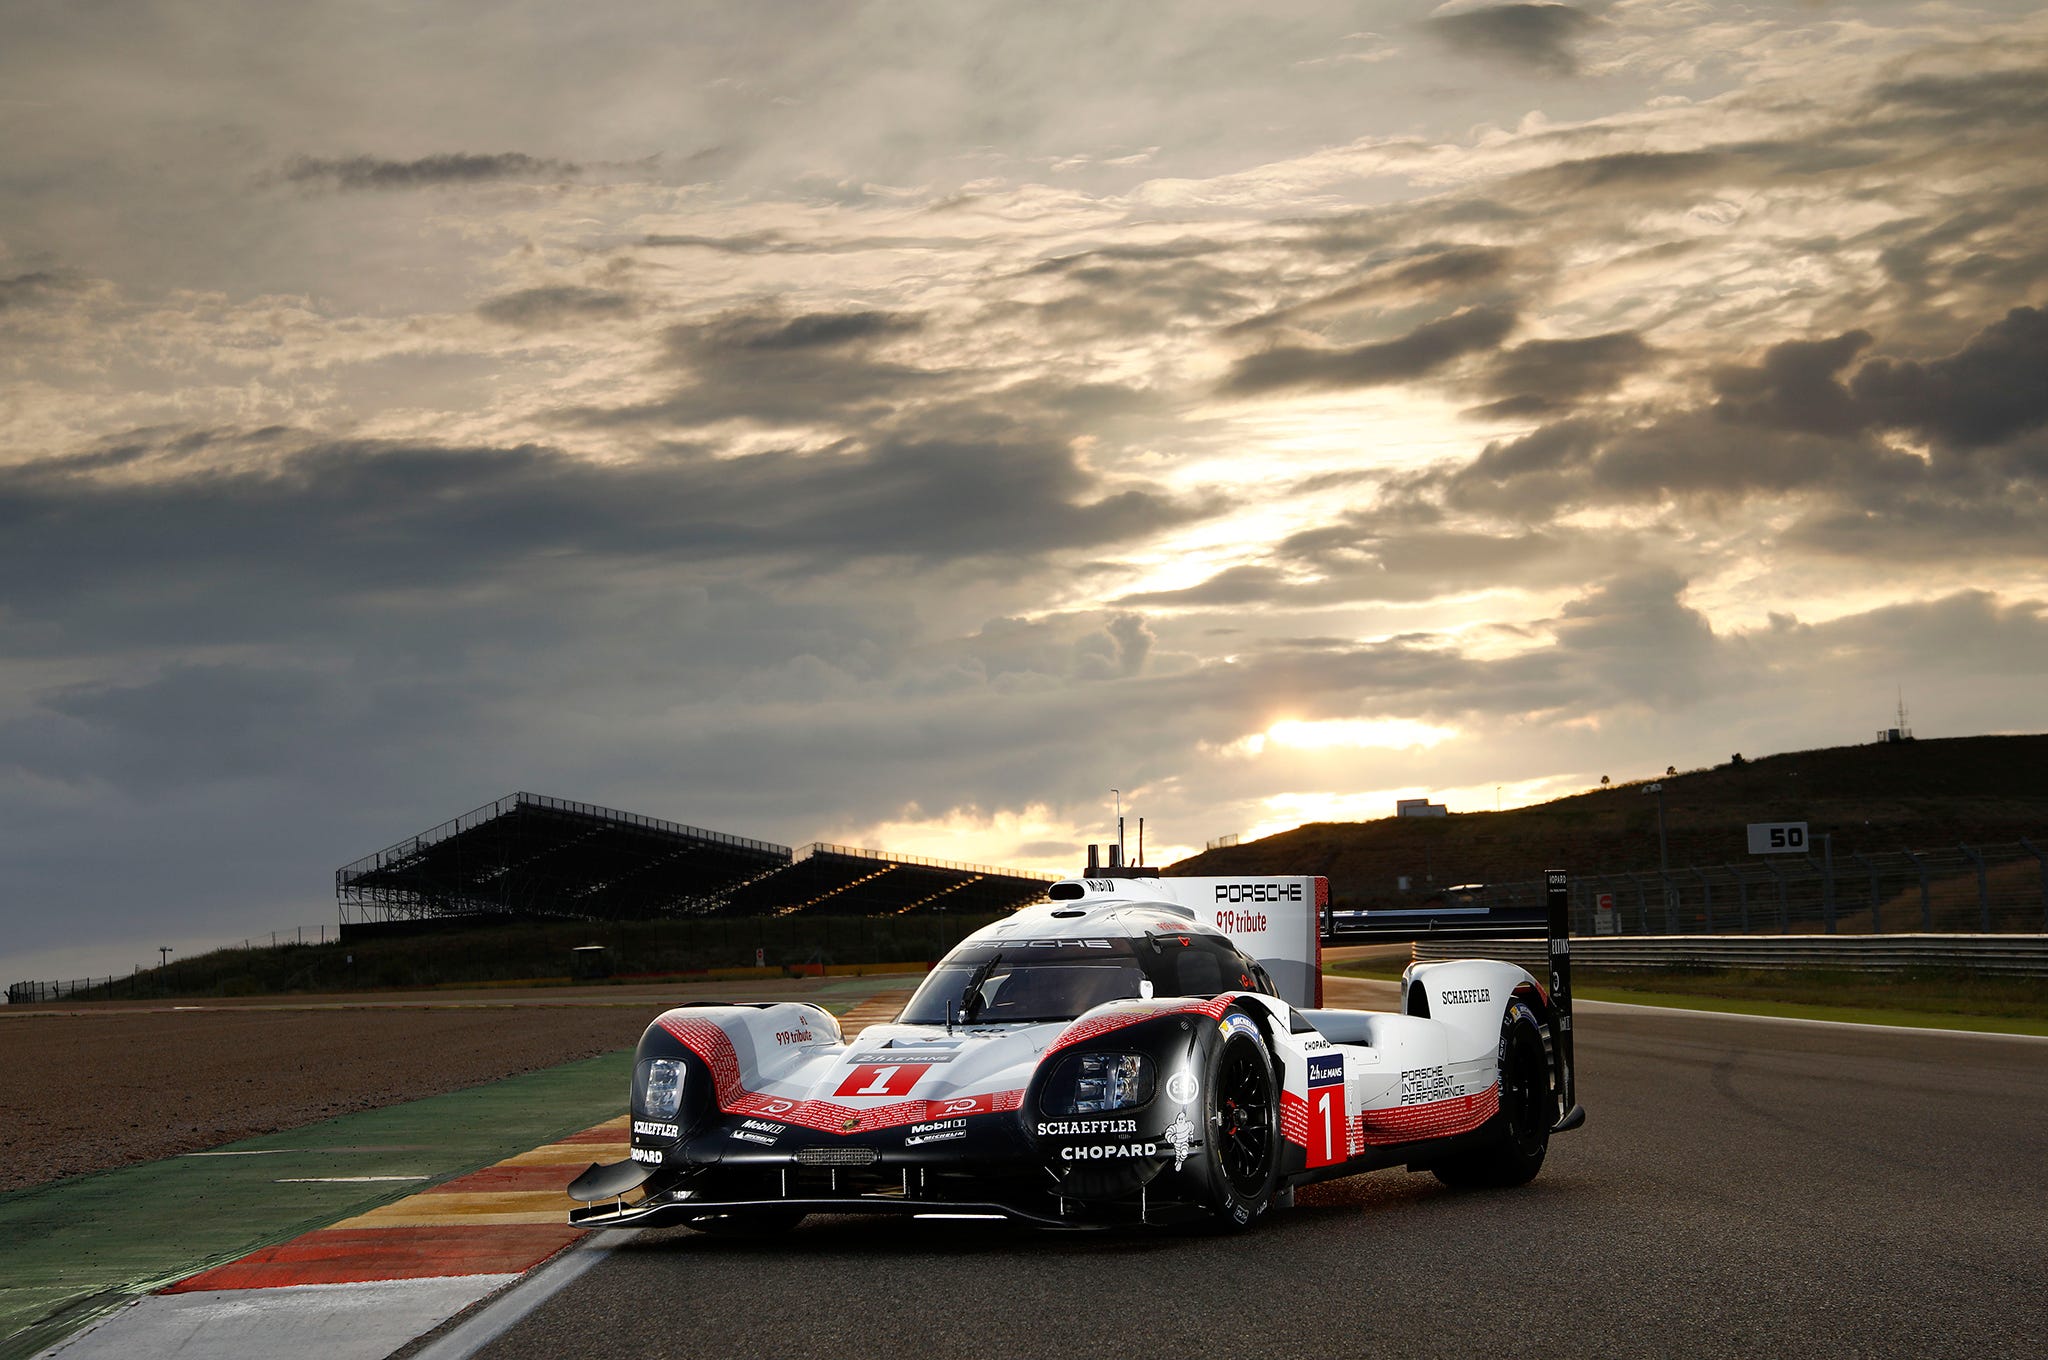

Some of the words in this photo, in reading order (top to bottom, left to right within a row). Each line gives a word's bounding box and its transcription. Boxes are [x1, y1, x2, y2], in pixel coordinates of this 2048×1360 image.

[1770, 828, 1803, 847] 50
[1215, 883, 1302, 903] PORSCHE
[1216, 910, 1235, 934] 919
[1236, 911, 1267, 933] tribute
[1441, 989, 1490, 1005] SCHAEFFLER
[776, 1031, 790, 1046] 919
[790, 1030, 812, 1043] tribute
[857, 1065, 901, 1094] 1
[1320, 1069, 1328, 1079] LE
[1327, 1067, 1342, 1078] MANS
[1401, 1065, 1443, 1082] PORSCHE
[1401, 1075, 1454, 1094] INTELLIGENT
[1400, 1084, 1465, 1105] PERFORMANCE
[634, 1120, 679, 1137] SCHAEFFLER
[741, 1120, 775, 1132] Mobil
[911, 1120, 951, 1133] Mobil
[1037, 1119, 1137, 1136] SCHAEFFLER
[1318, 1092, 1333, 1161] 1
[923, 1131, 965, 1141] MICHELIN
[1061, 1143, 1157, 1160] CHOPARD
